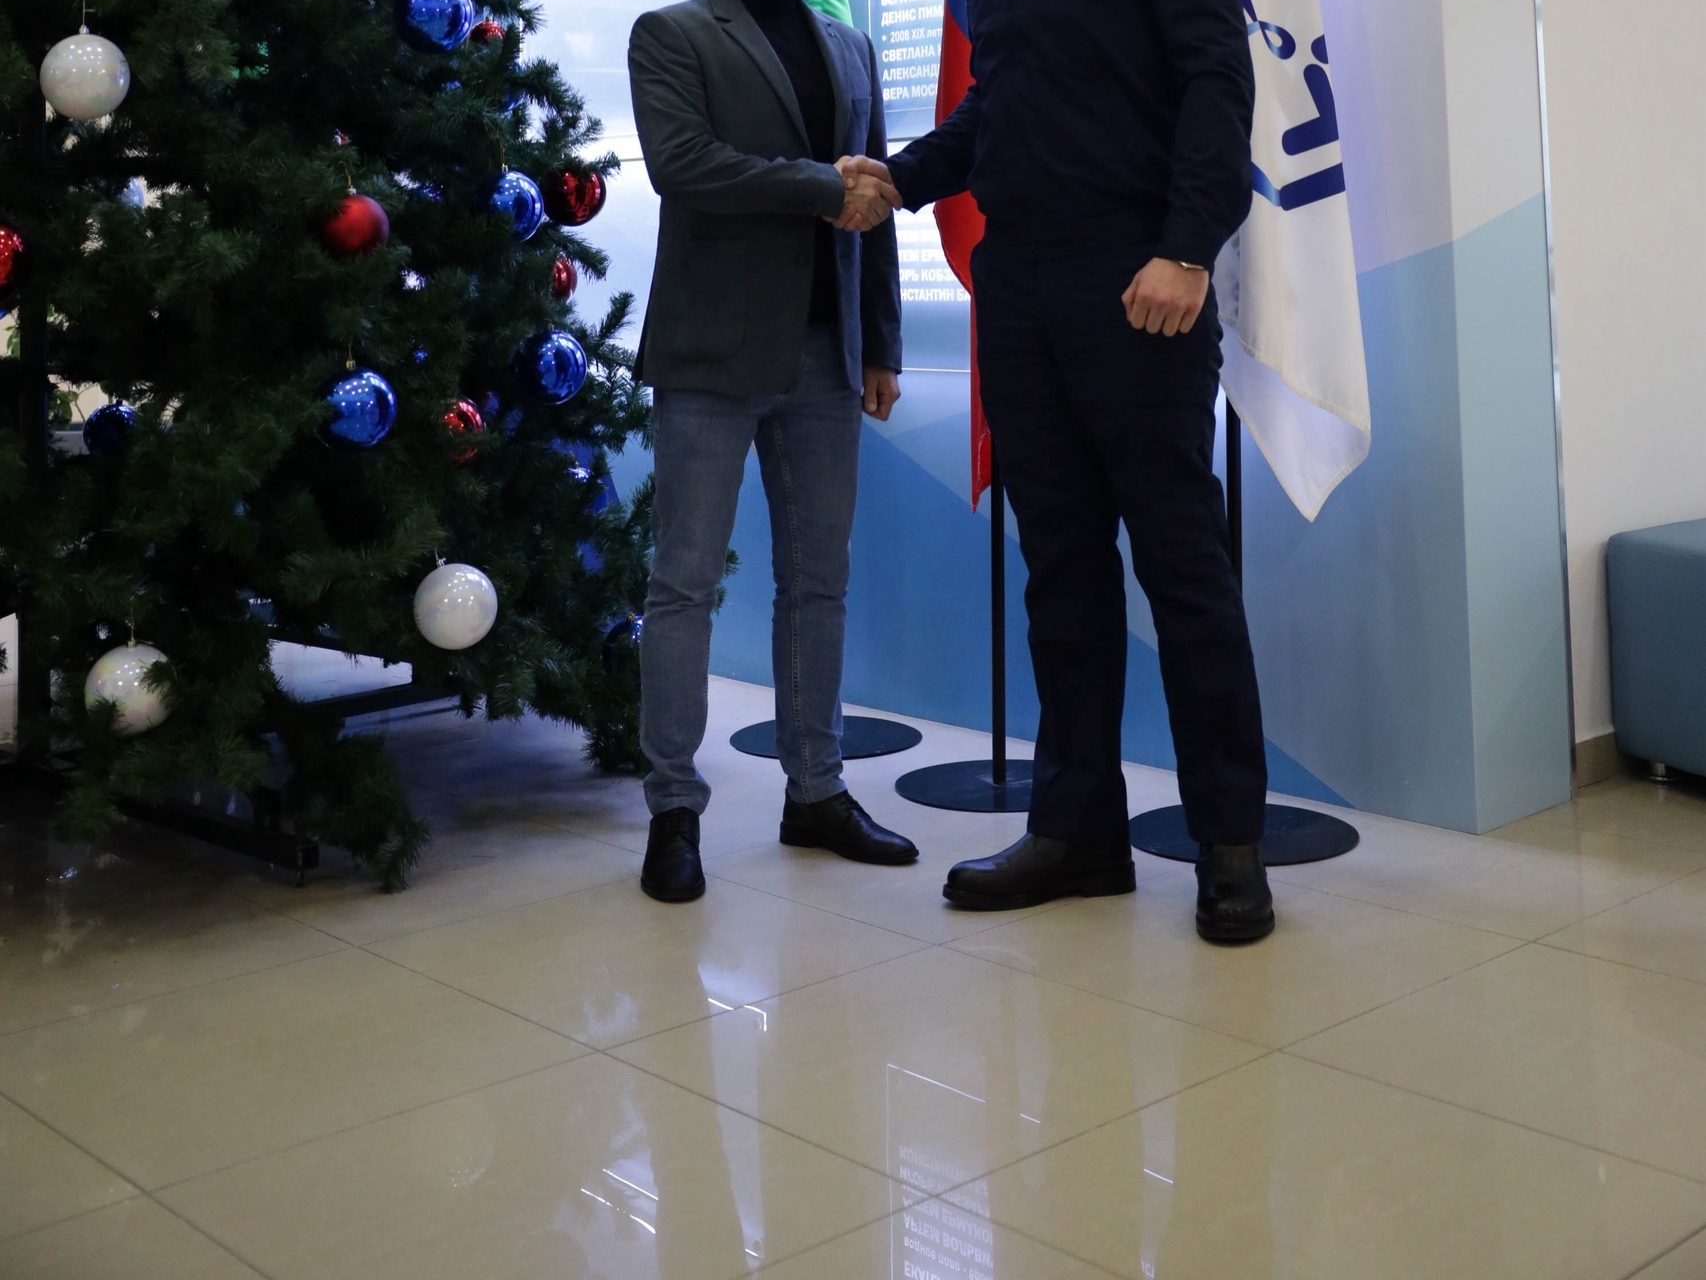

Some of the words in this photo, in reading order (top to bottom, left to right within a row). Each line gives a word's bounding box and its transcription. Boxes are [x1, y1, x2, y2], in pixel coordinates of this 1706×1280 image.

[880, 9, 917, 28] ДЕНИС
[918, 5, 944, 20] ПИМ
[890, 30, 910, 43] 2008
[911, 28, 925, 39] XIX
[881, 44, 935, 62] СВЕТЛАНА
[882, 63, 940, 83] АЛЕКСАНД
[883, 86, 909, 101] ВЕРА
[911, 84, 938, 98] МОС
[900, 268, 918, 282] ОРЬ
[901, 288, 953, 301] НСТАНТИН
